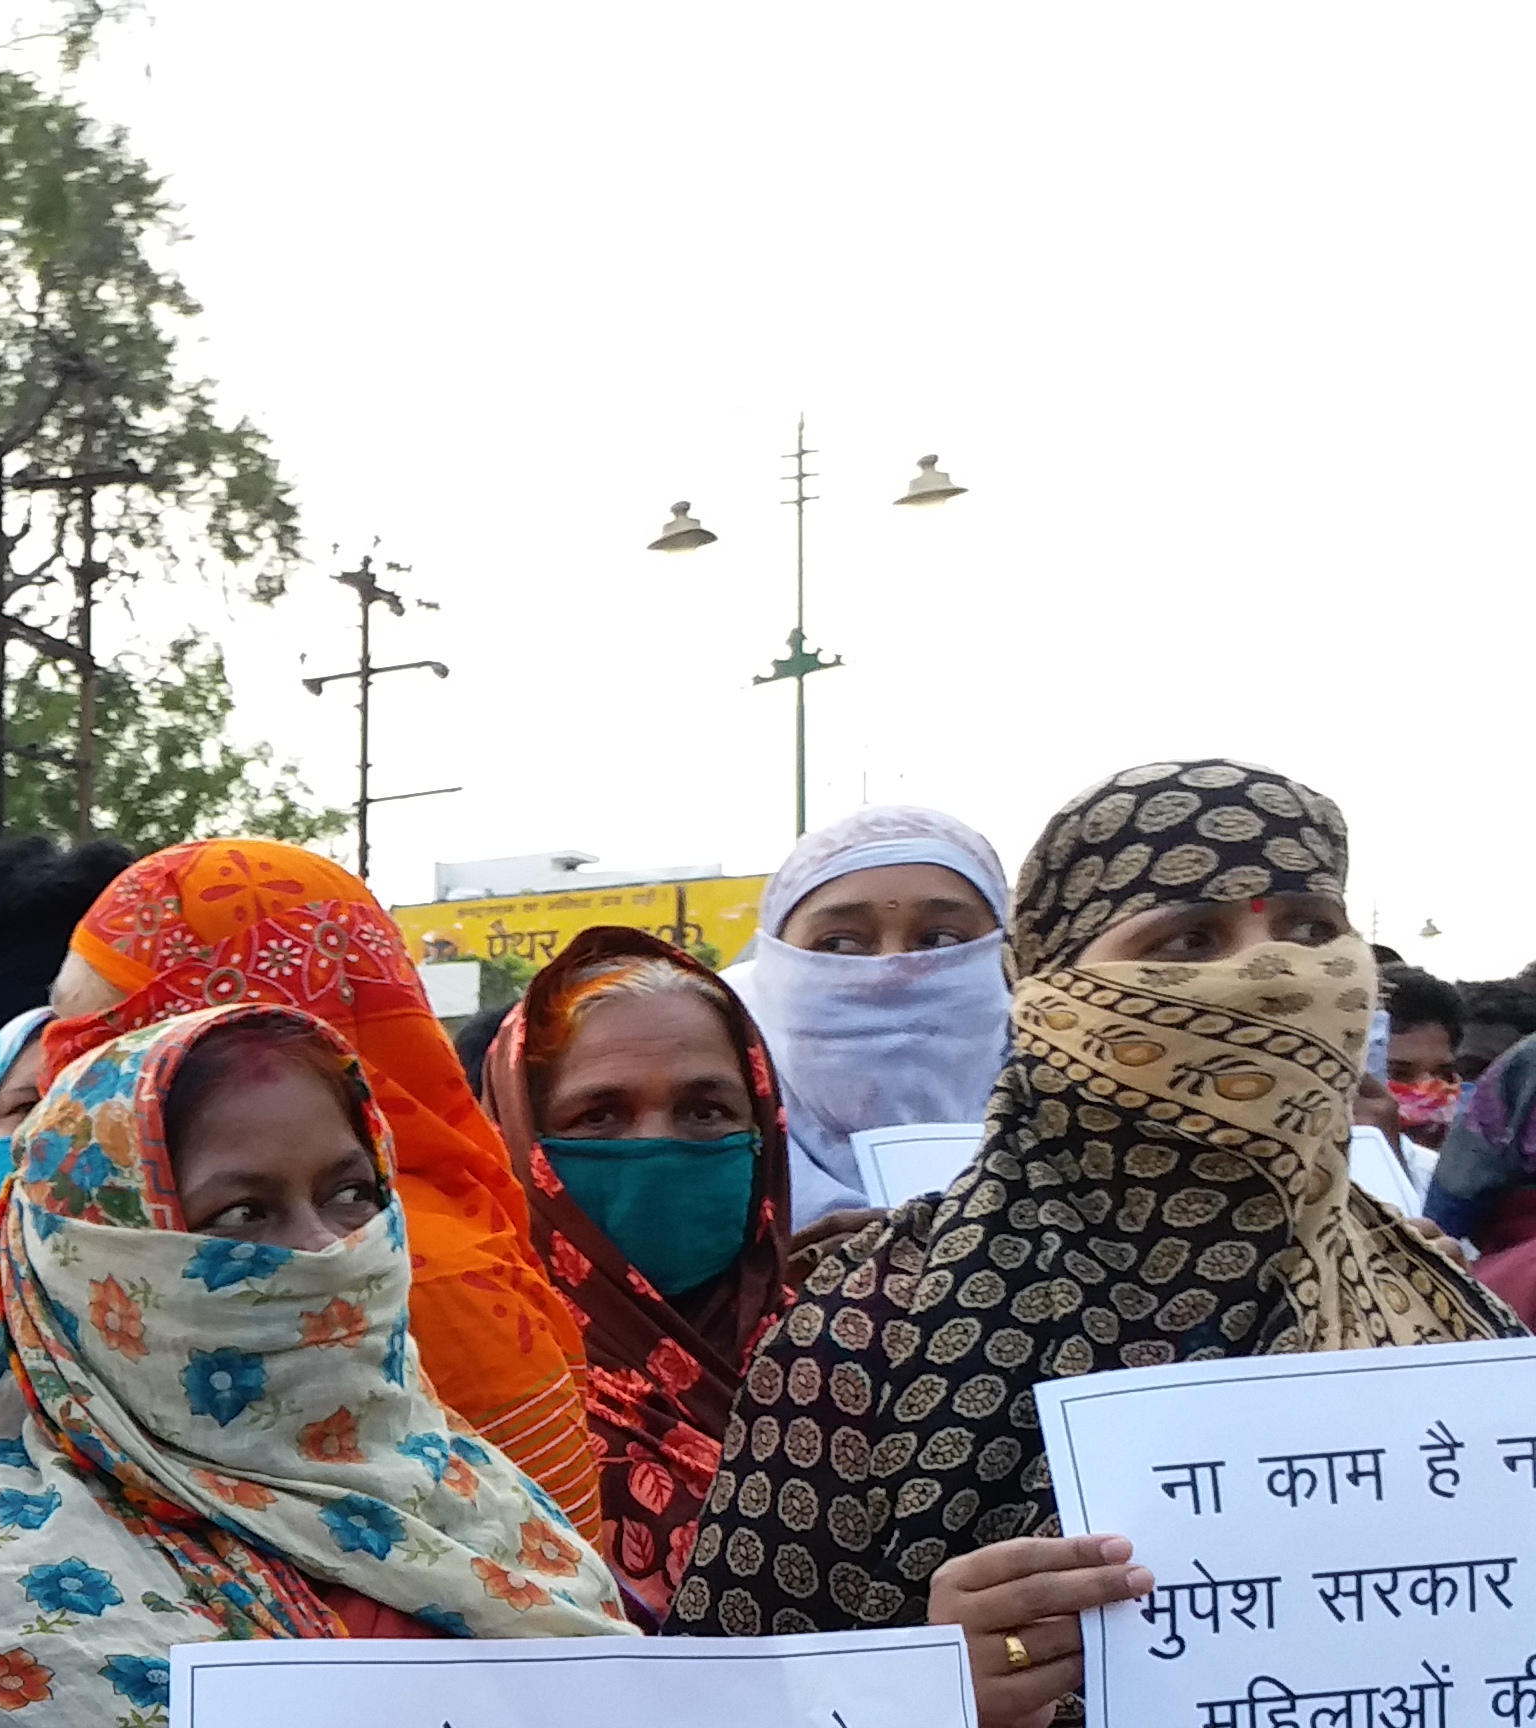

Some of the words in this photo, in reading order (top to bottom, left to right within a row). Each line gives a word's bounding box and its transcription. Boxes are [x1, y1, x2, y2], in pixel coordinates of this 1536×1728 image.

[1153, 1461, 1225, 1514] ना
[1259, 1449, 1385, 1507] काम
[1420, 1422, 1463, 1498] है
[1312, 1558, 1517, 1622] सरकार
